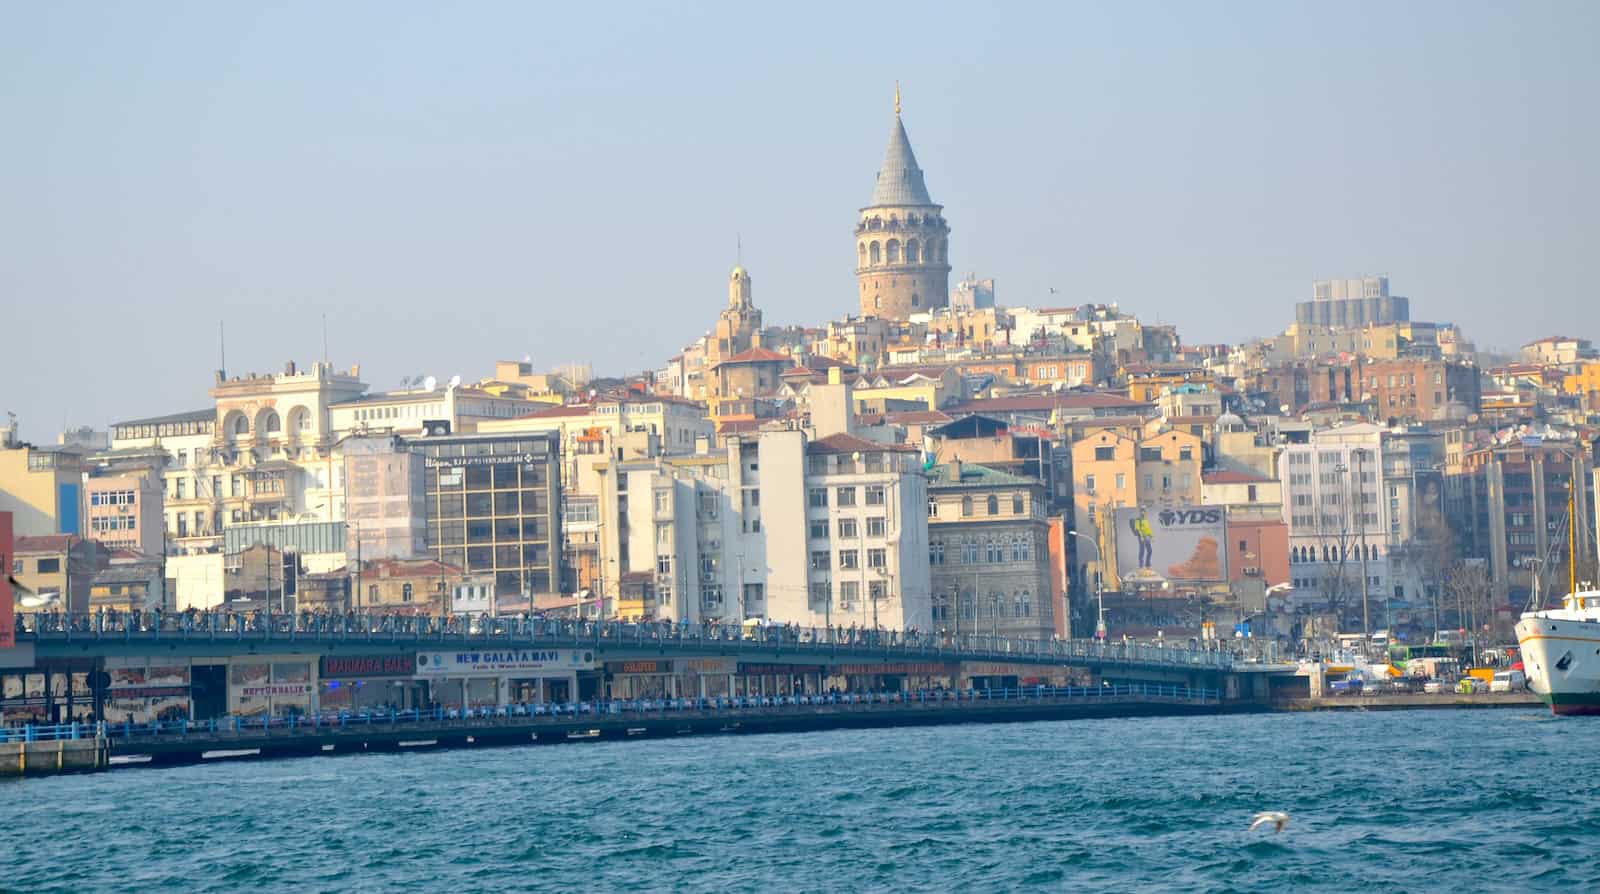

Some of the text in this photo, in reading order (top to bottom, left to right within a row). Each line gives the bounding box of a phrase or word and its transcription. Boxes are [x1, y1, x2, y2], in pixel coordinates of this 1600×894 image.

[1176, 510, 1219, 524] YDS
[456, 652, 480, 664] NEW
[483, 651, 528, 663] GALATA
